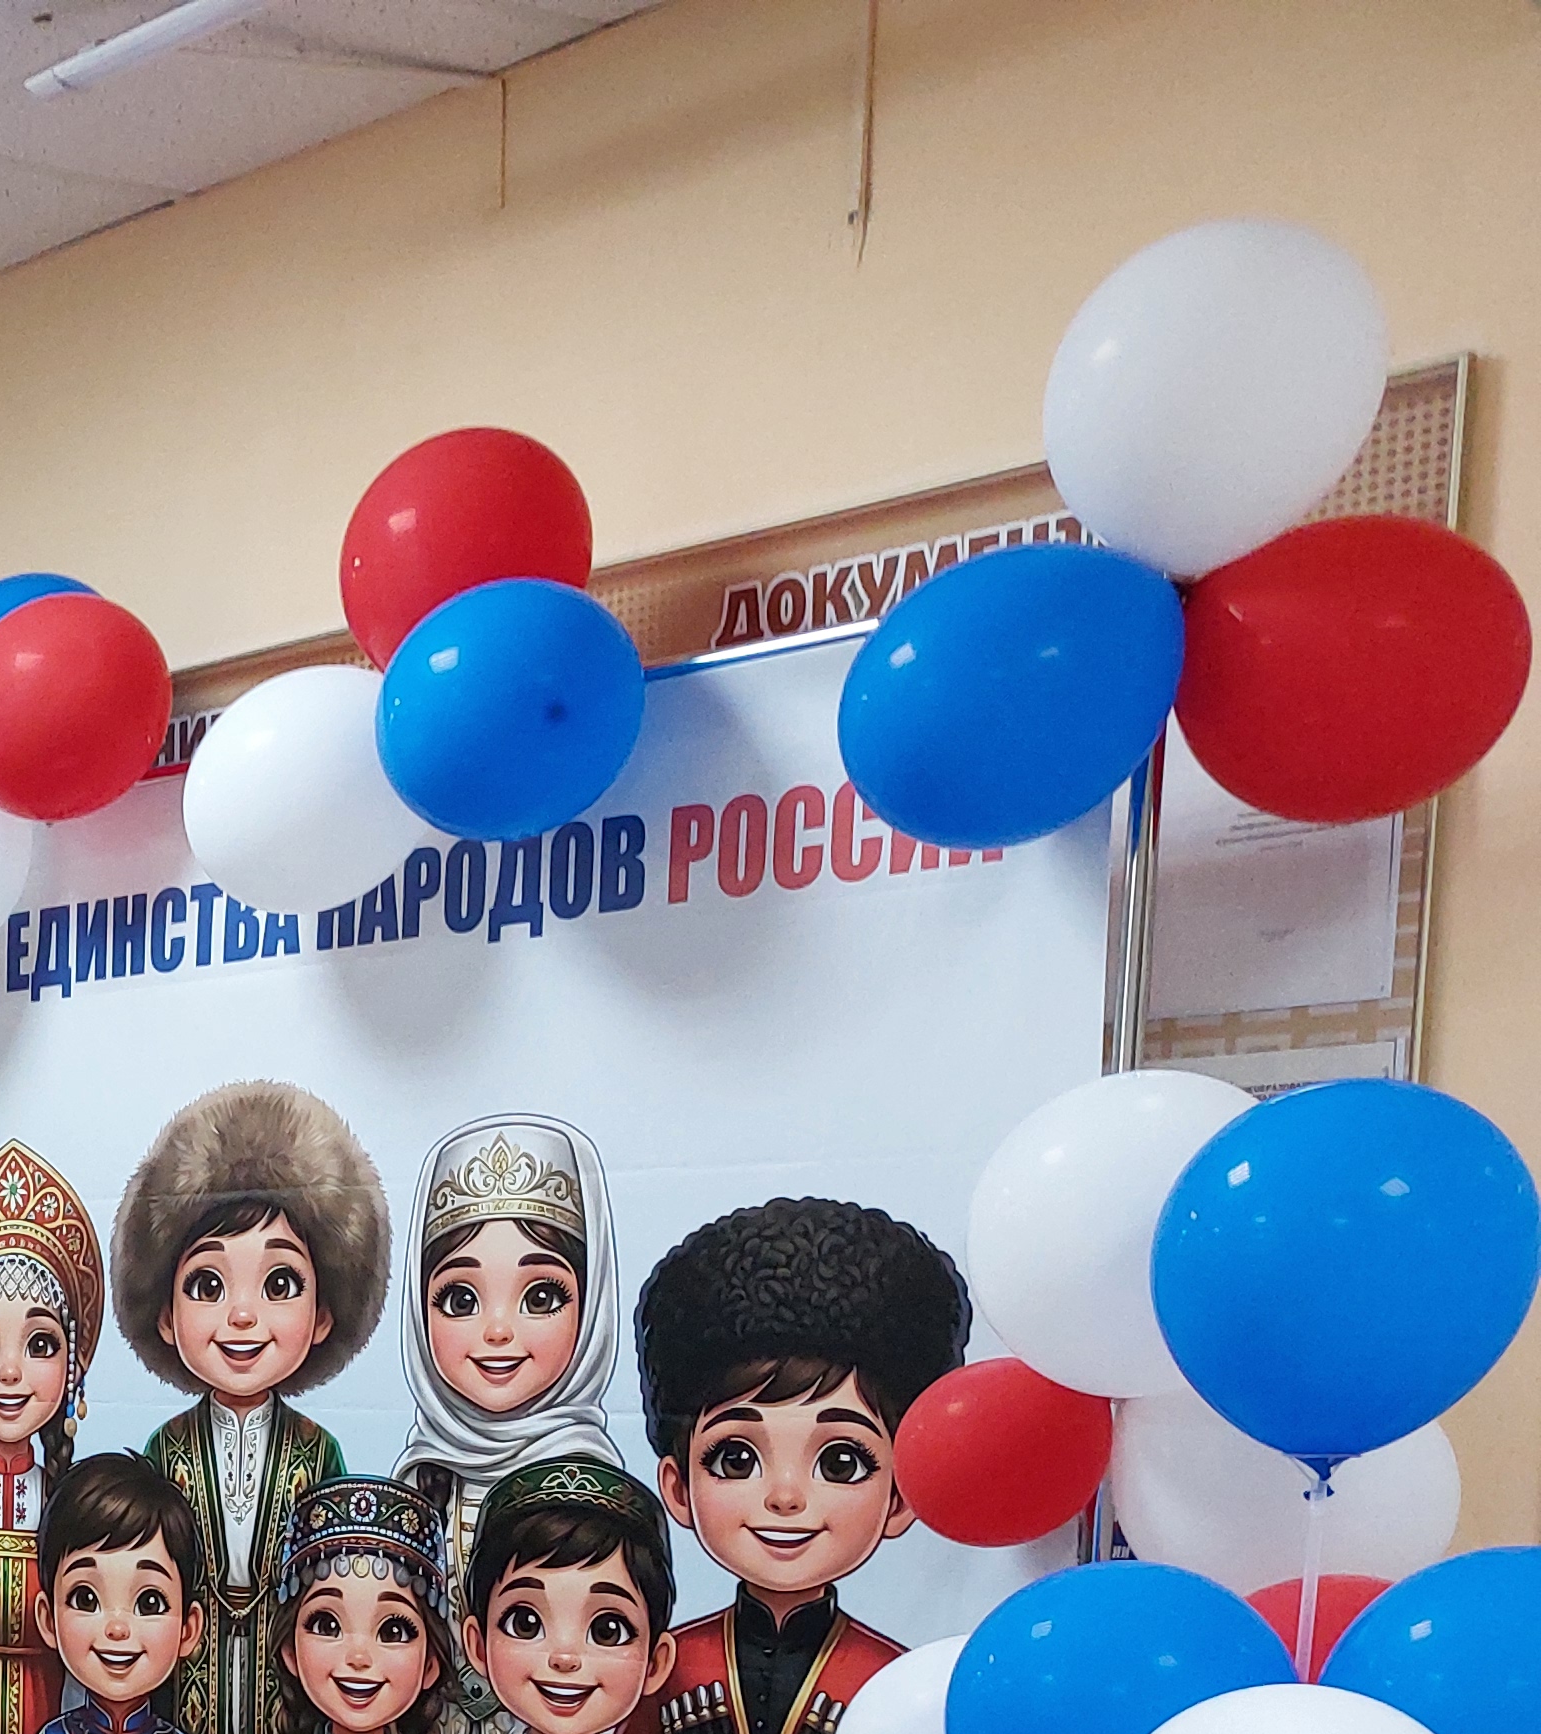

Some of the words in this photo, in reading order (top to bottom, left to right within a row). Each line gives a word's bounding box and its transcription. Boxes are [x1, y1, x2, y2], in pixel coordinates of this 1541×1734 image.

[712, 510, 1110, 648] ДОКУМ
[7, 883, 301, 1002] ЕДИНСТВА
[668, 781, 1005, 905] РОСС
